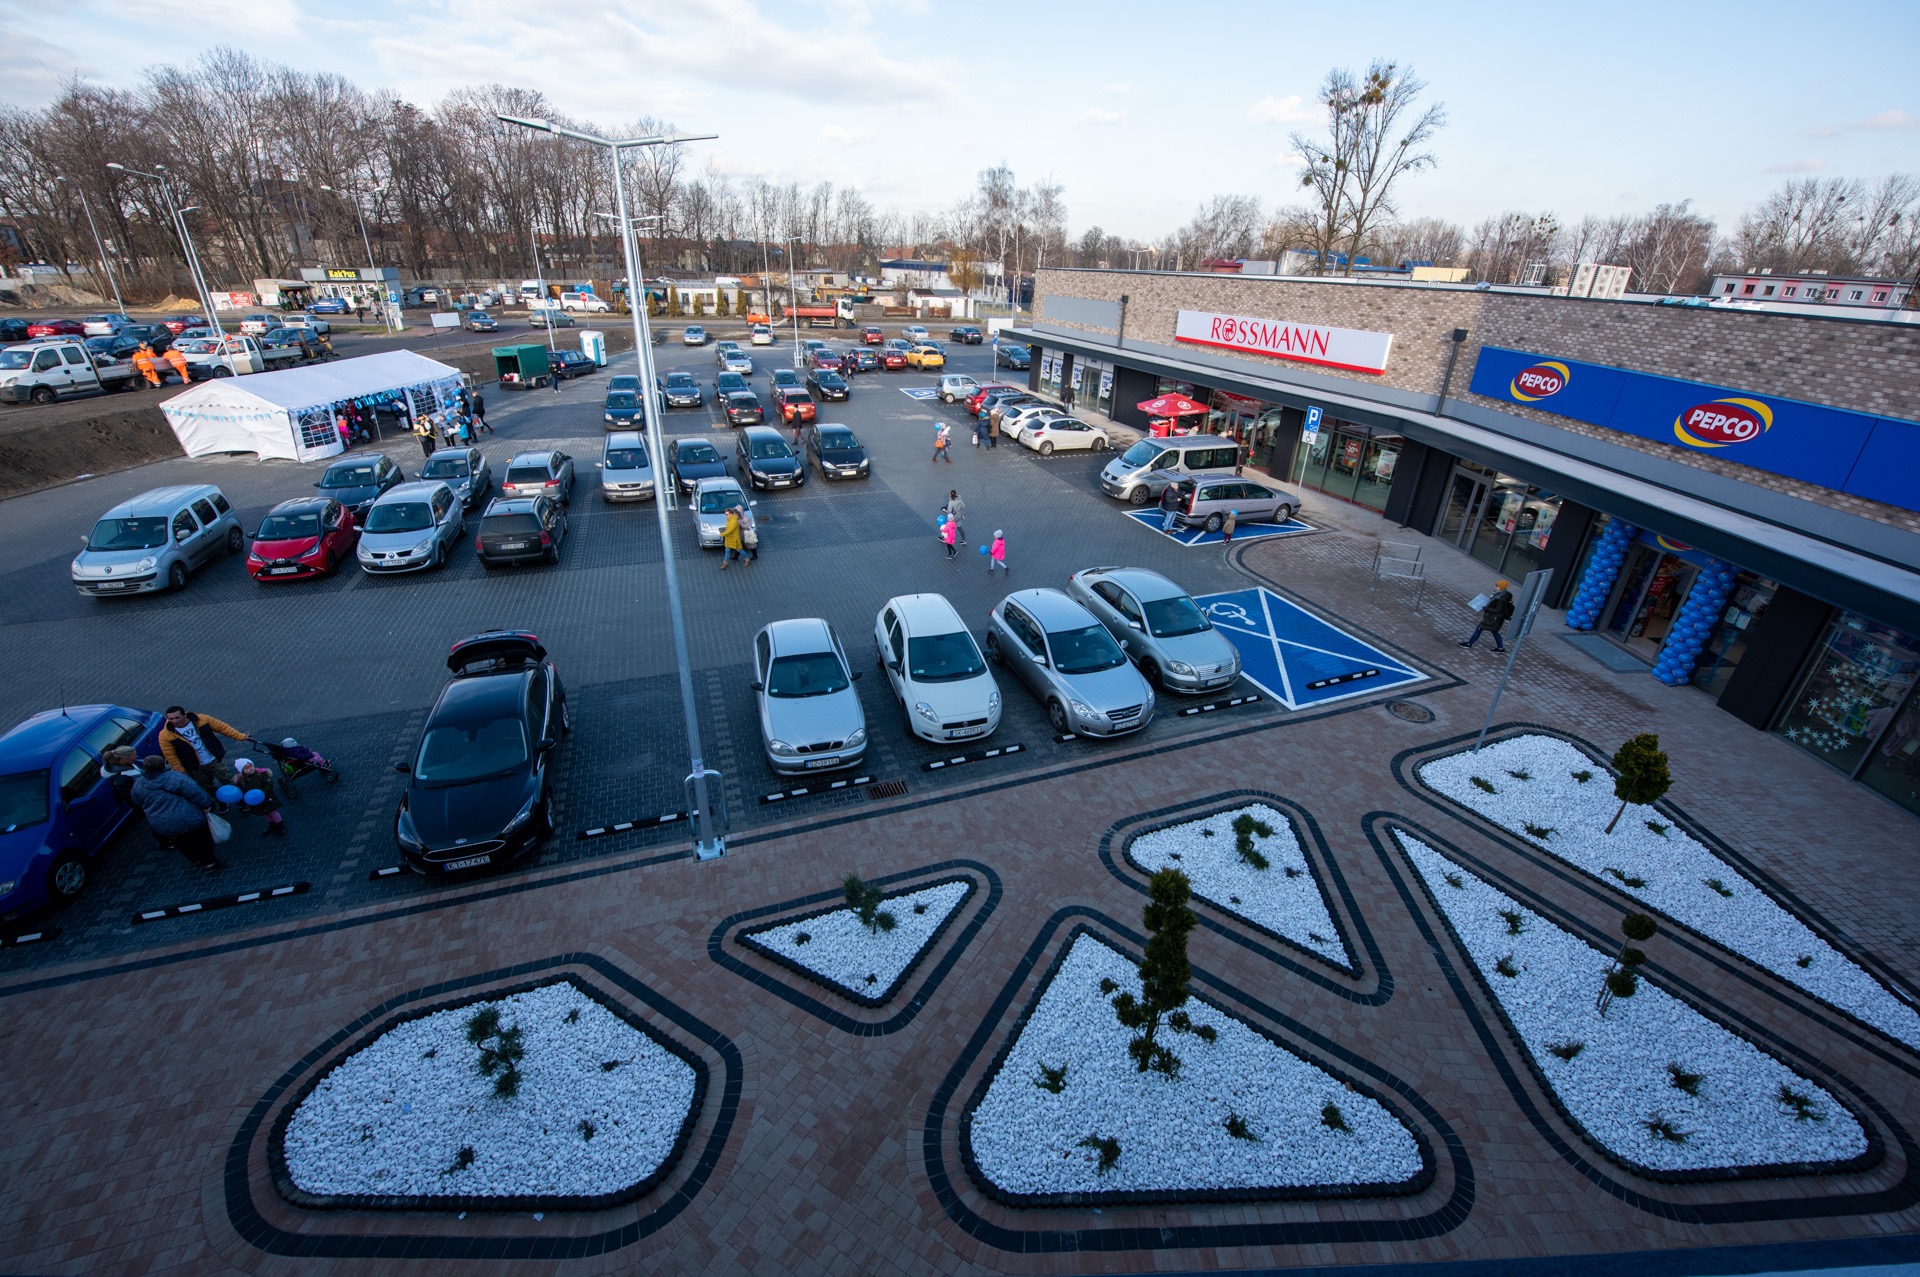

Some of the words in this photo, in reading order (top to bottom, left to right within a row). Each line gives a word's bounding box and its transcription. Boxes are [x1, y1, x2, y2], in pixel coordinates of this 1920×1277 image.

[1210, 317, 1331, 357] ROSSMANN
[1518, 372, 1559, 392] PEPCO
[1308, 409, 1319, 425] P
[1688, 409, 1755, 438] PEPCO
